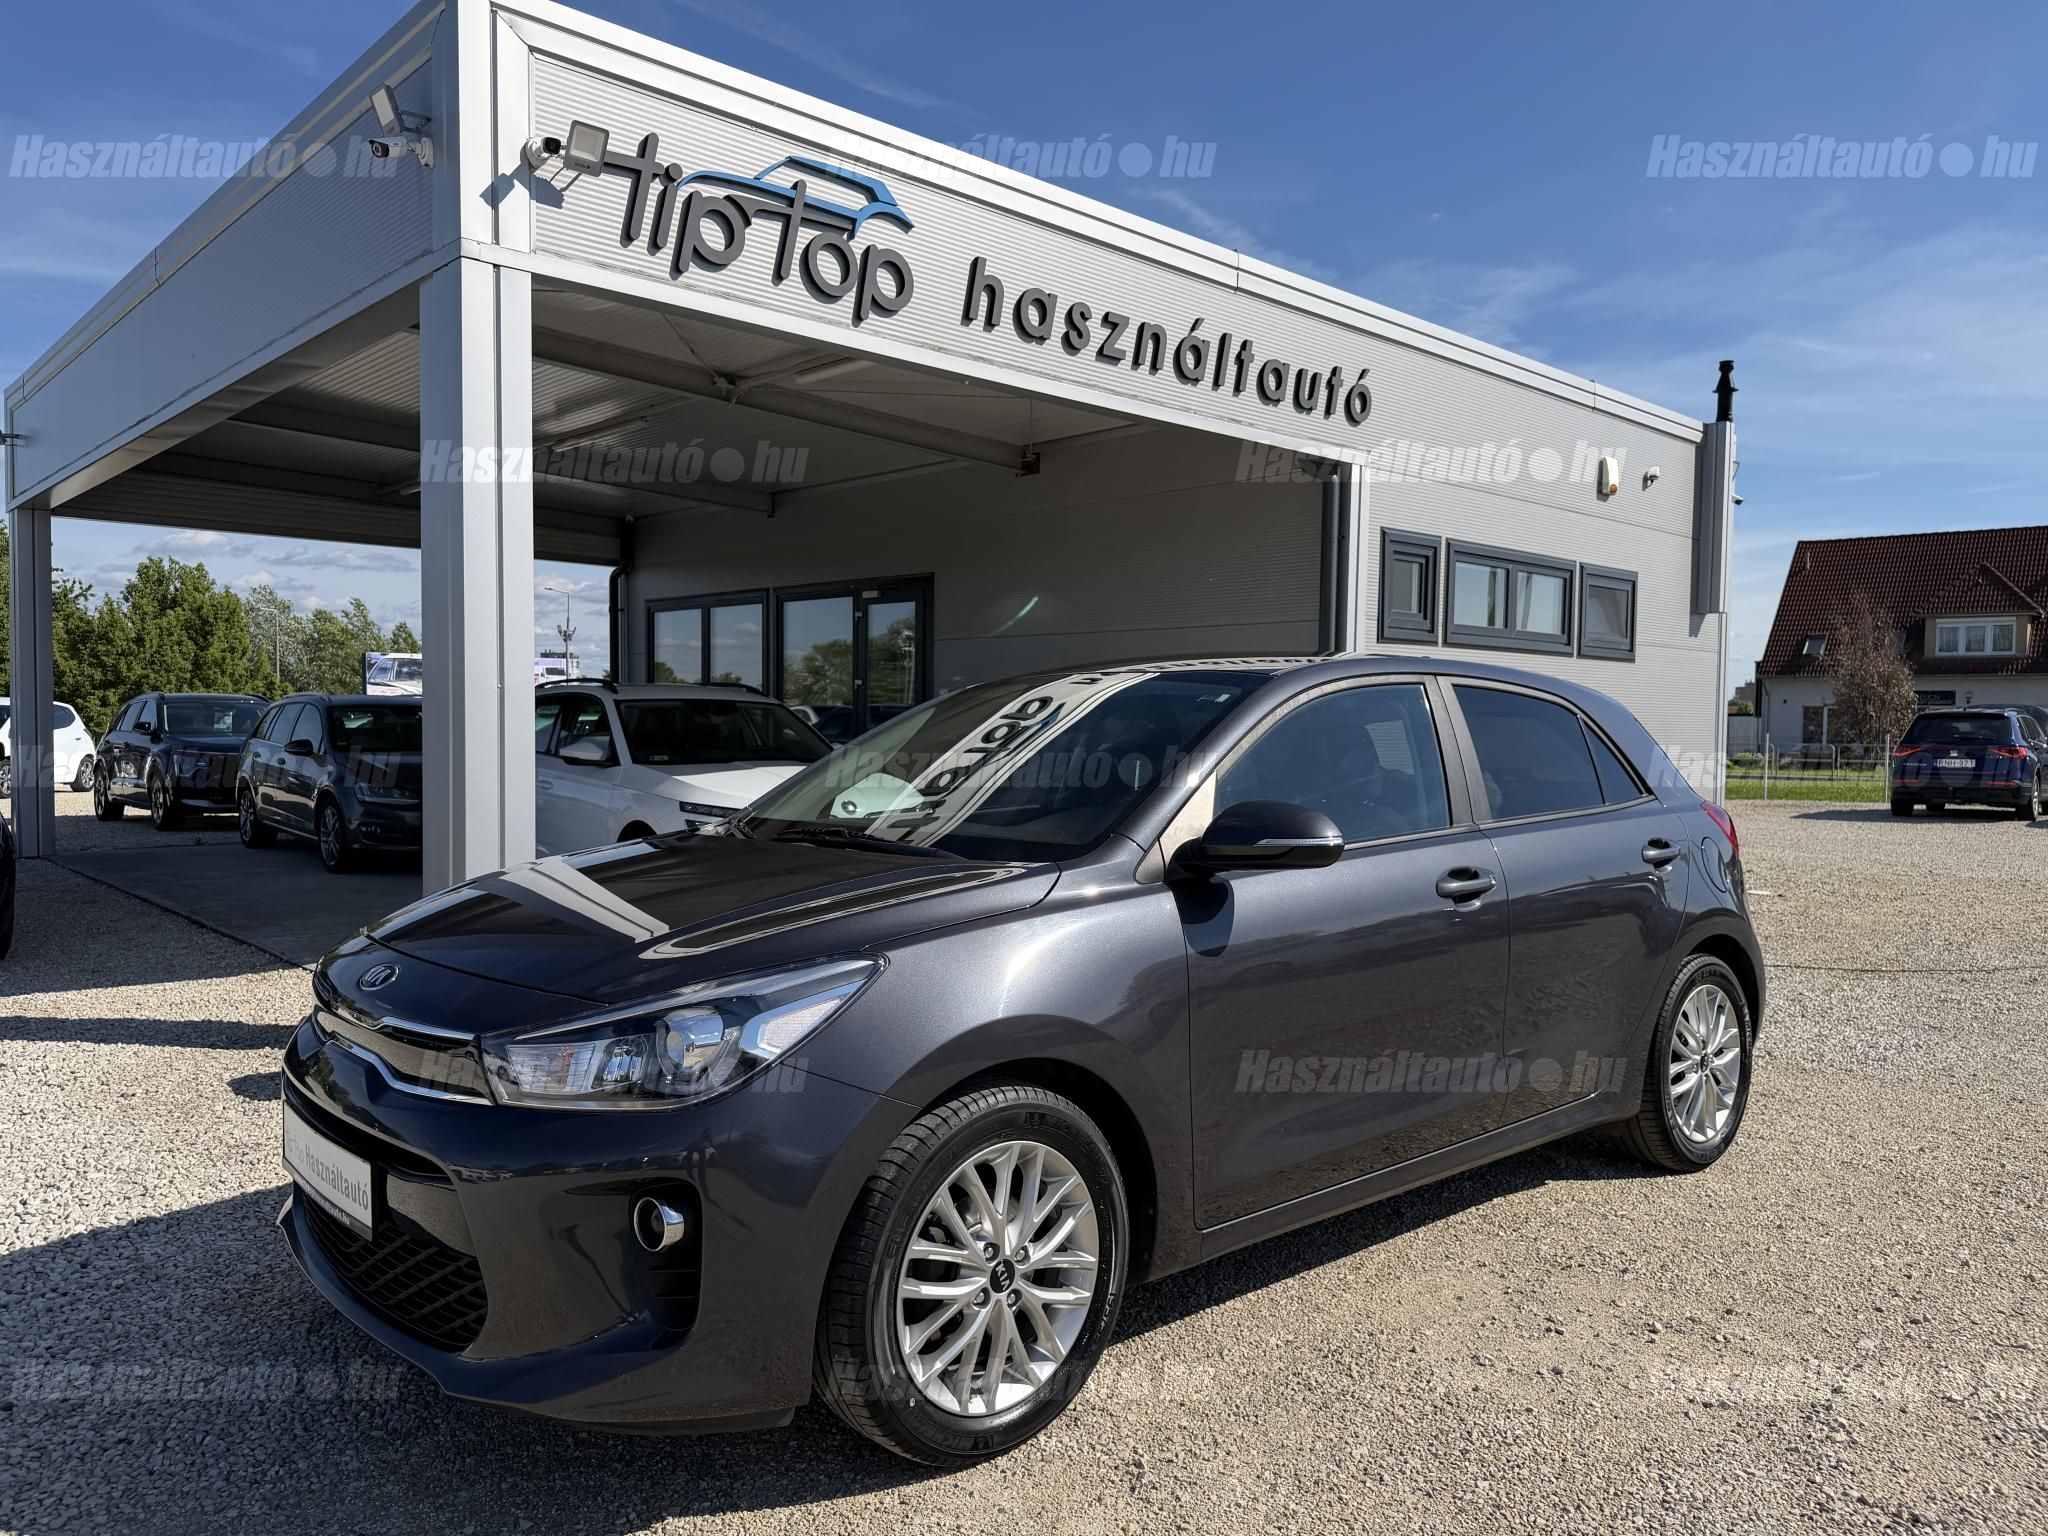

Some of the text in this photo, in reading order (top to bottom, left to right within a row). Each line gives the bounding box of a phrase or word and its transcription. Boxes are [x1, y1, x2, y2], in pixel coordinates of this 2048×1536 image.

[961, 256, 1371, 425] használtautó
[305, 1142, 369, 1211] Használtautó
[995, 1259, 1010, 1291] KIA
